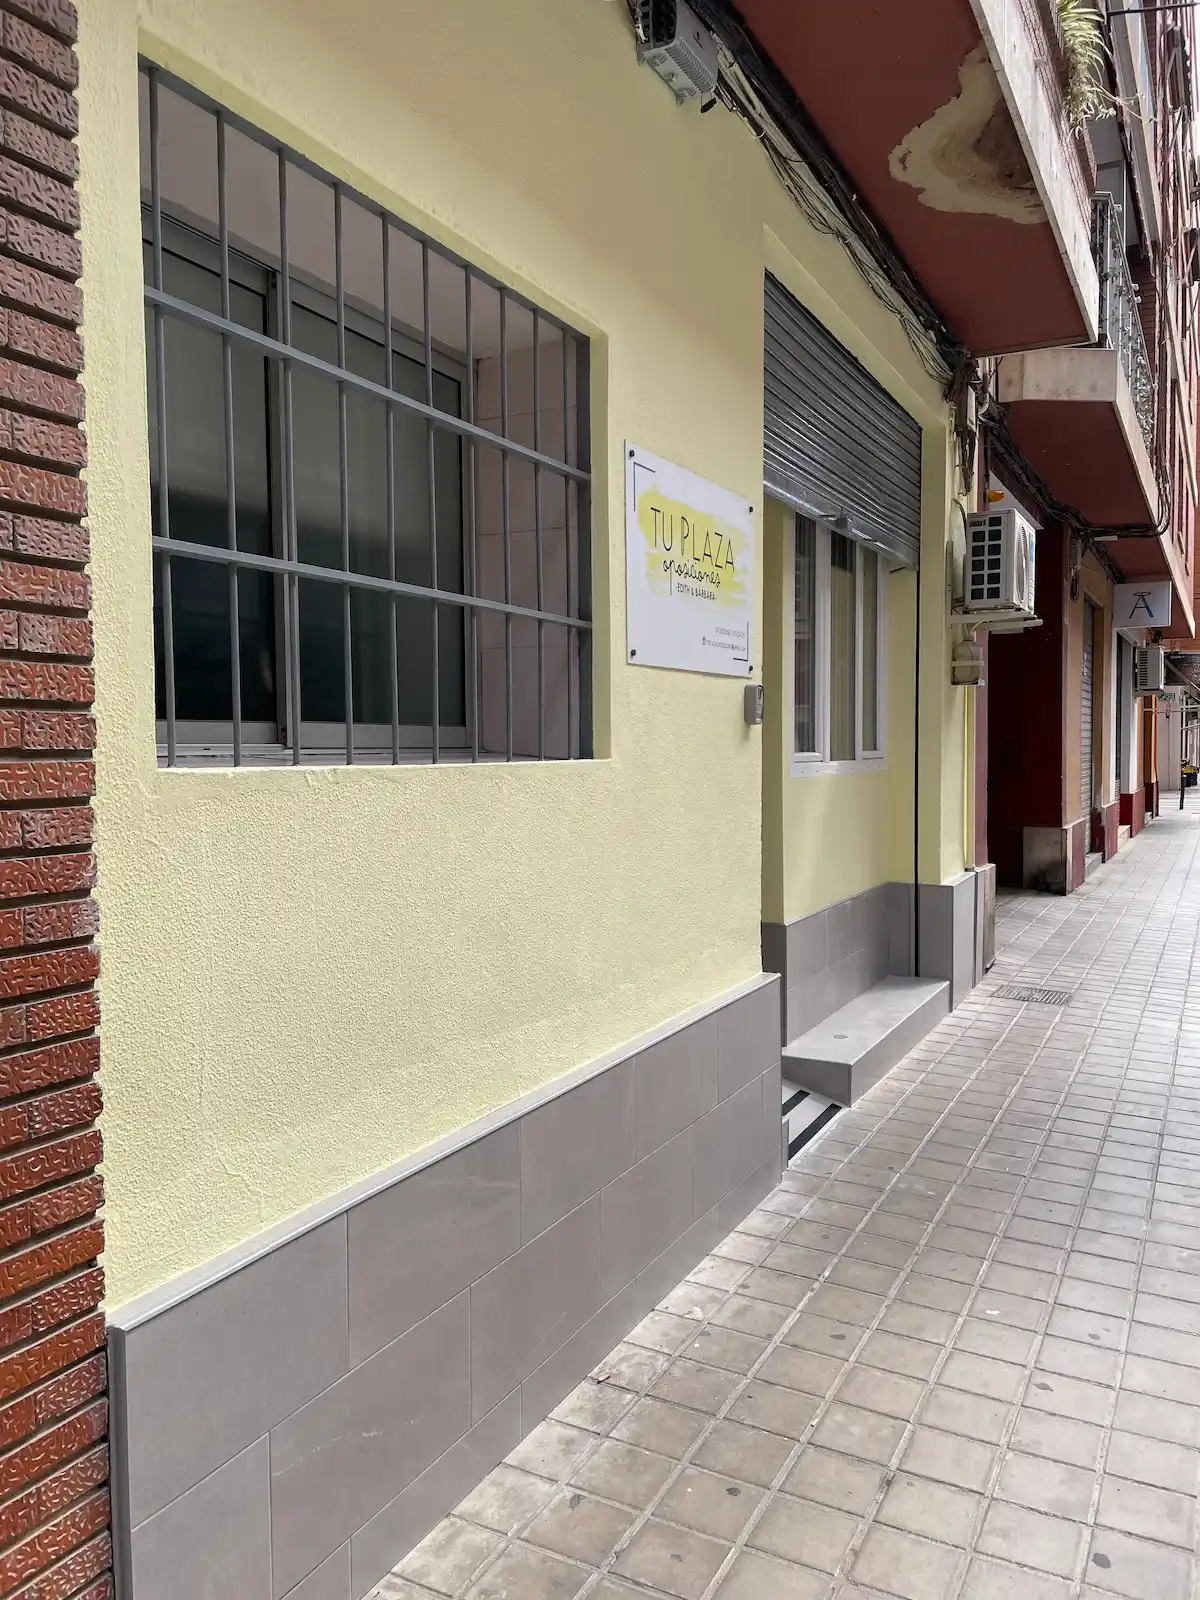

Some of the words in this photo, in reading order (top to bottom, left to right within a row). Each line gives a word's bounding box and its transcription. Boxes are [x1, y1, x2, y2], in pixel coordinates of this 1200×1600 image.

[650, 507, 673, 552] TU
[681, 516, 735, 573] PLAZA
[663, 559, 721, 595] oposiciones
